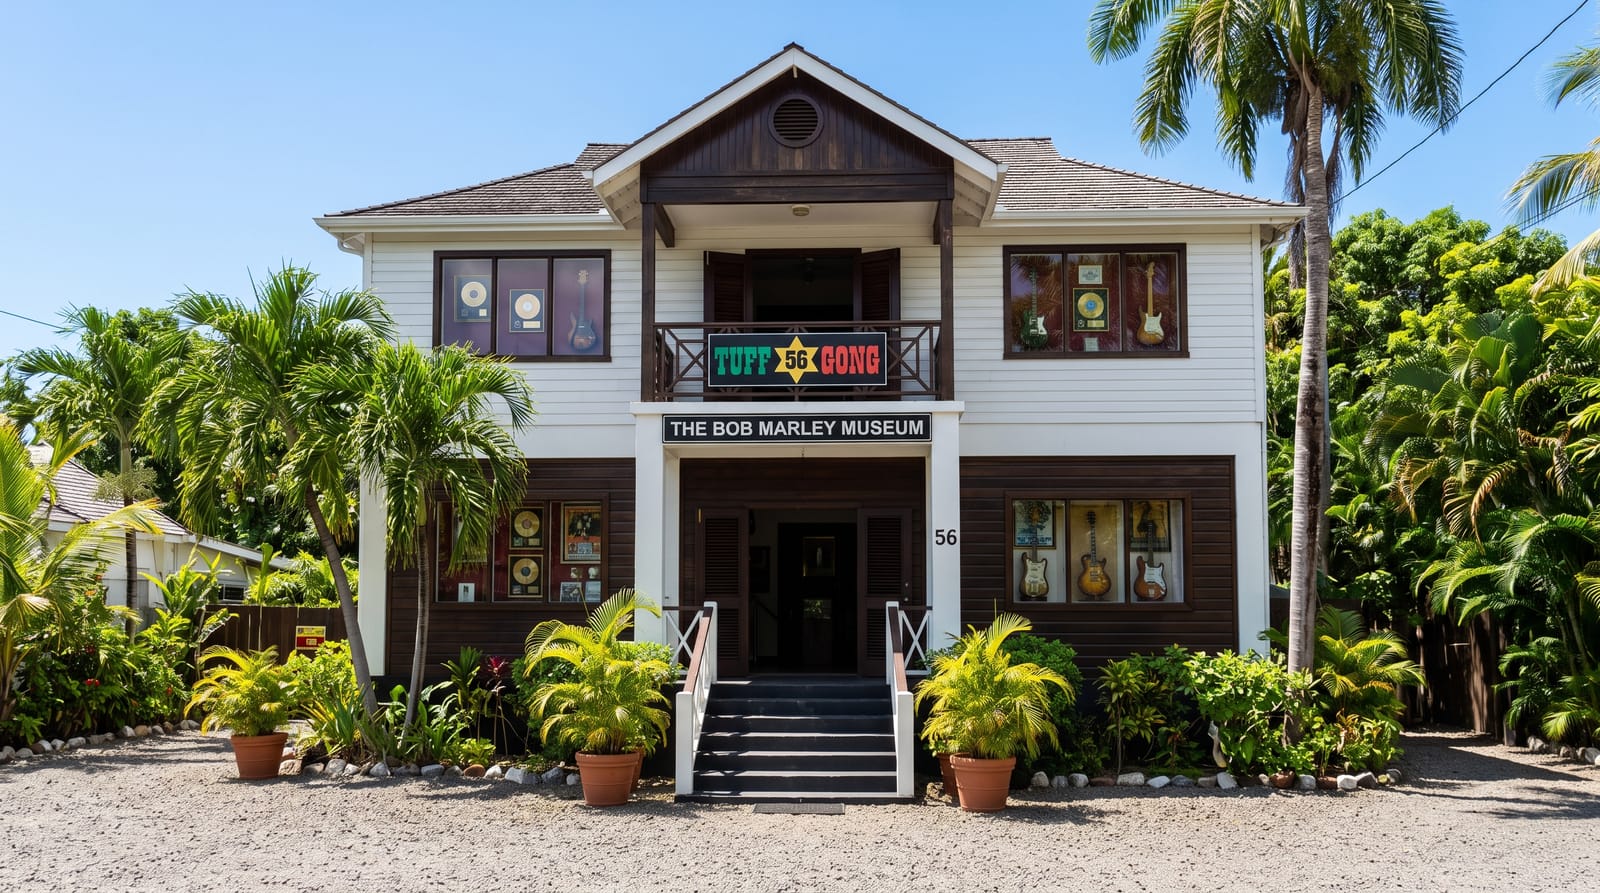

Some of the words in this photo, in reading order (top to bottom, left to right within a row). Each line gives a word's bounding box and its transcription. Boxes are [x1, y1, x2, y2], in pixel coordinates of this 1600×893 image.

[714, 345, 772, 376] TUFF
[785, 349, 808, 370] 56
[820, 345, 881, 375] GONG
[670, 421, 708, 437] THE
[712, 421, 753, 436] BOB
[759, 420, 836, 436] MARLEY
[841, 419, 924, 436] MUSEUM
[935, 528, 958, 546] 56
